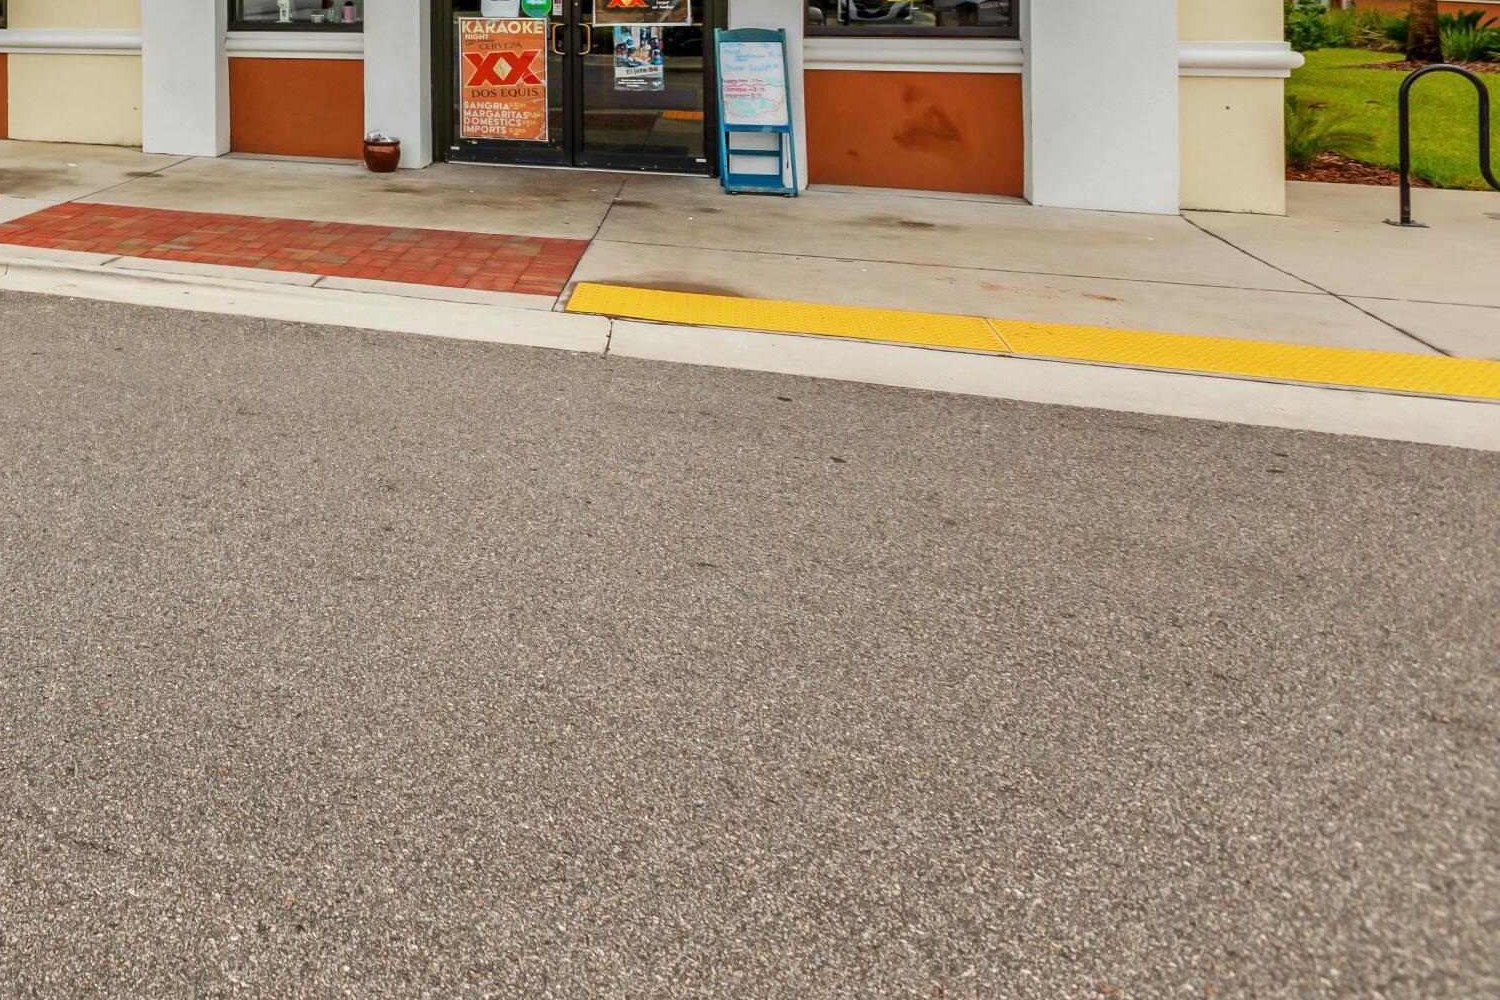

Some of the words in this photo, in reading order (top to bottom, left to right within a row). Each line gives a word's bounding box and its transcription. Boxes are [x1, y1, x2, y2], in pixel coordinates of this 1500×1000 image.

[461, 20, 544, 34] KARAOKE
[479, 41, 523, 50] CERVEZA
[471, 88, 497, 98] DOS
[501, 87, 540, 98] EQUIS
[463, 101, 510, 110] SANGRIA
[463, 110, 529, 119] MARGARITAS
[463, 118, 522, 127] DOMESTICS
[463, 126, 507, 134] IMPORTS
